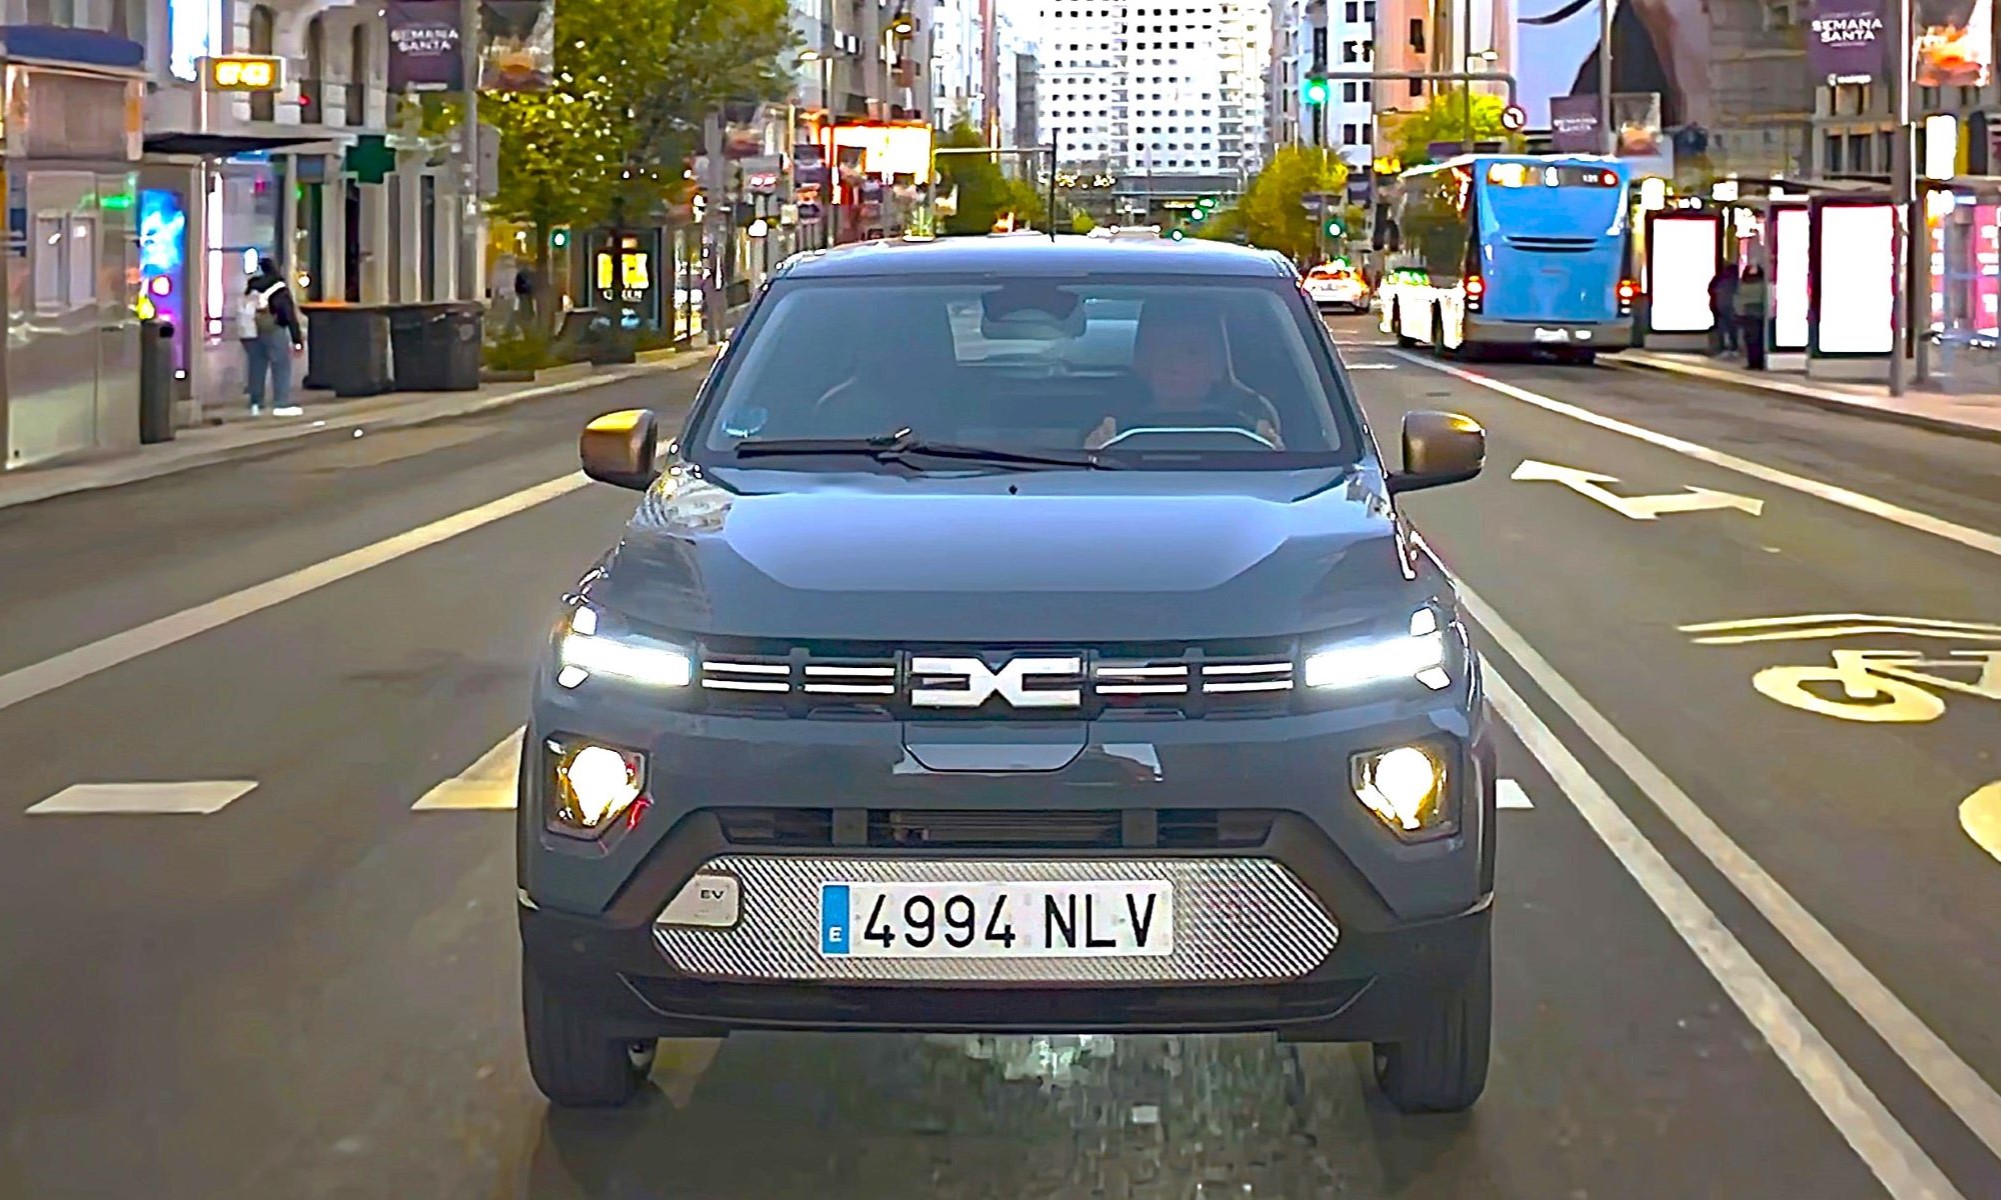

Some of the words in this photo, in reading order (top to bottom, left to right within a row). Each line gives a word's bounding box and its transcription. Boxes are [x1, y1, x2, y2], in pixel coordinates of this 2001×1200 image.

[1811, 18, 1883, 32] SEMANA
[1821, 30, 1875, 43] SANTA
[700, 889, 724, 900] EV
[829, 927, 842, 942] E
[864, 894, 1016, 949] 4994
[1045, 893, 1157, 949] NLV
